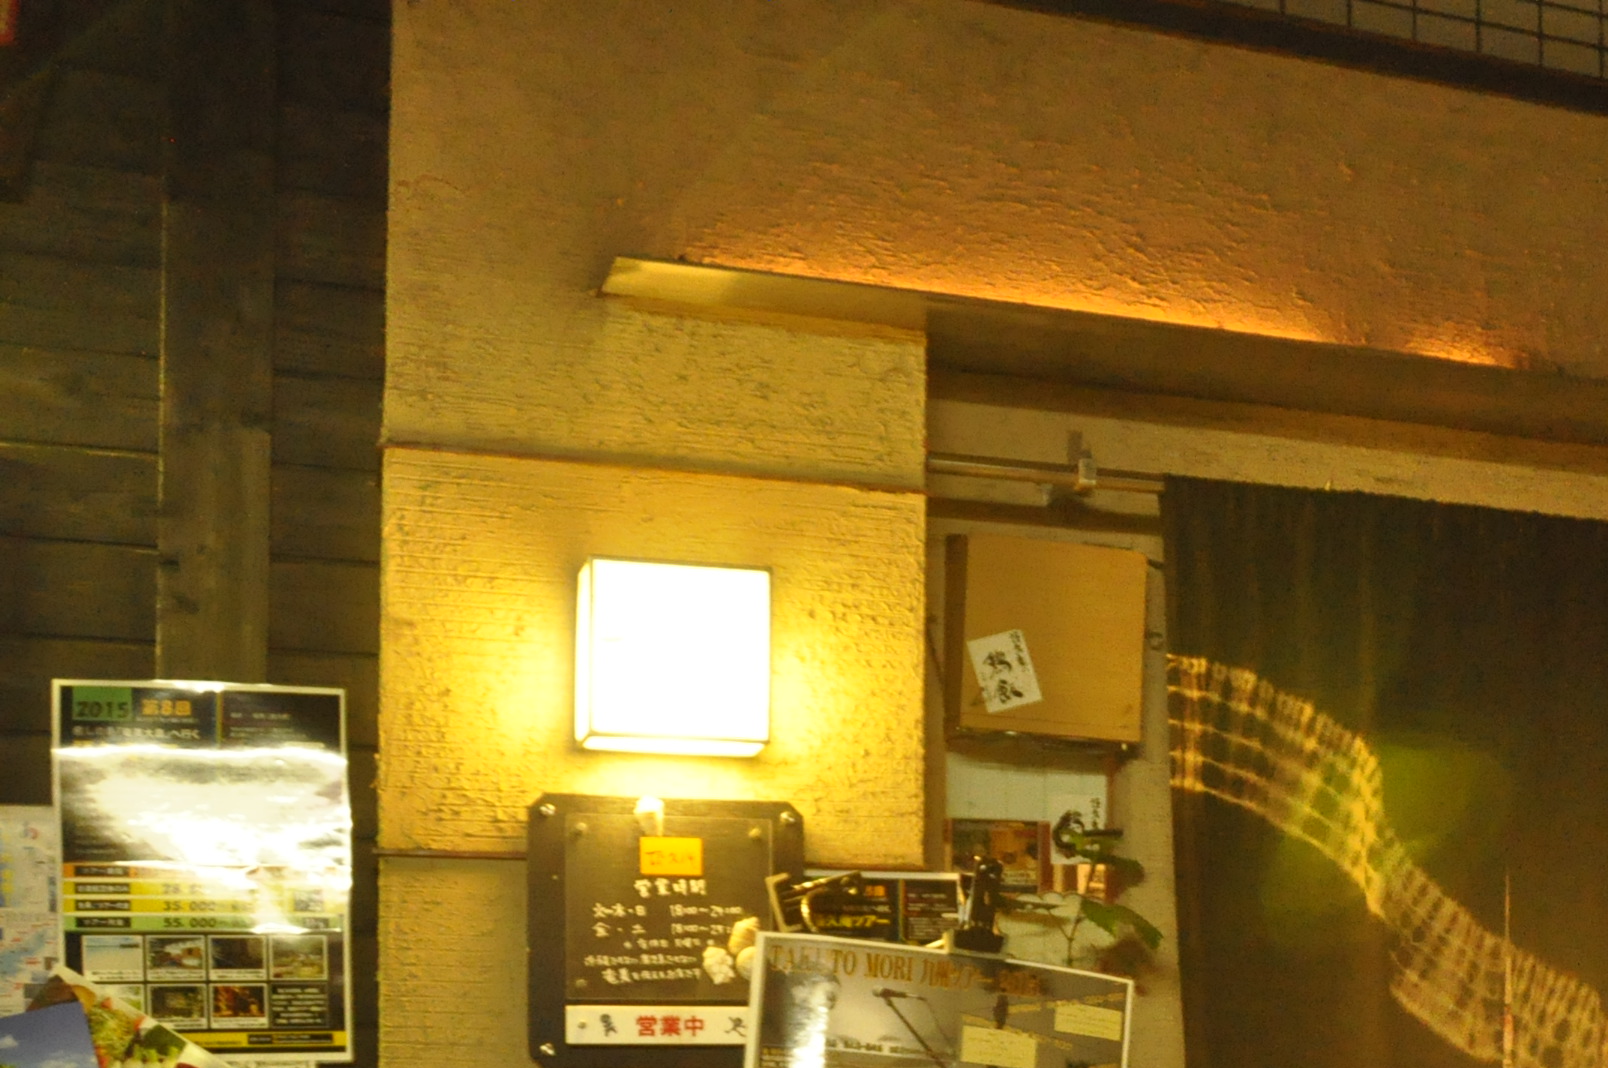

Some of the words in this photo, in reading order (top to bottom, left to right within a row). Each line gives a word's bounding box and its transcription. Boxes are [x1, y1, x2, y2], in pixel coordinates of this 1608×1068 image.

[633, 877, 707, 899] 営業時間
[831, 949, 857, 976] TO
[863, 952, 913, 982] MORI
[635, 1015, 705, 1038] 営業中
